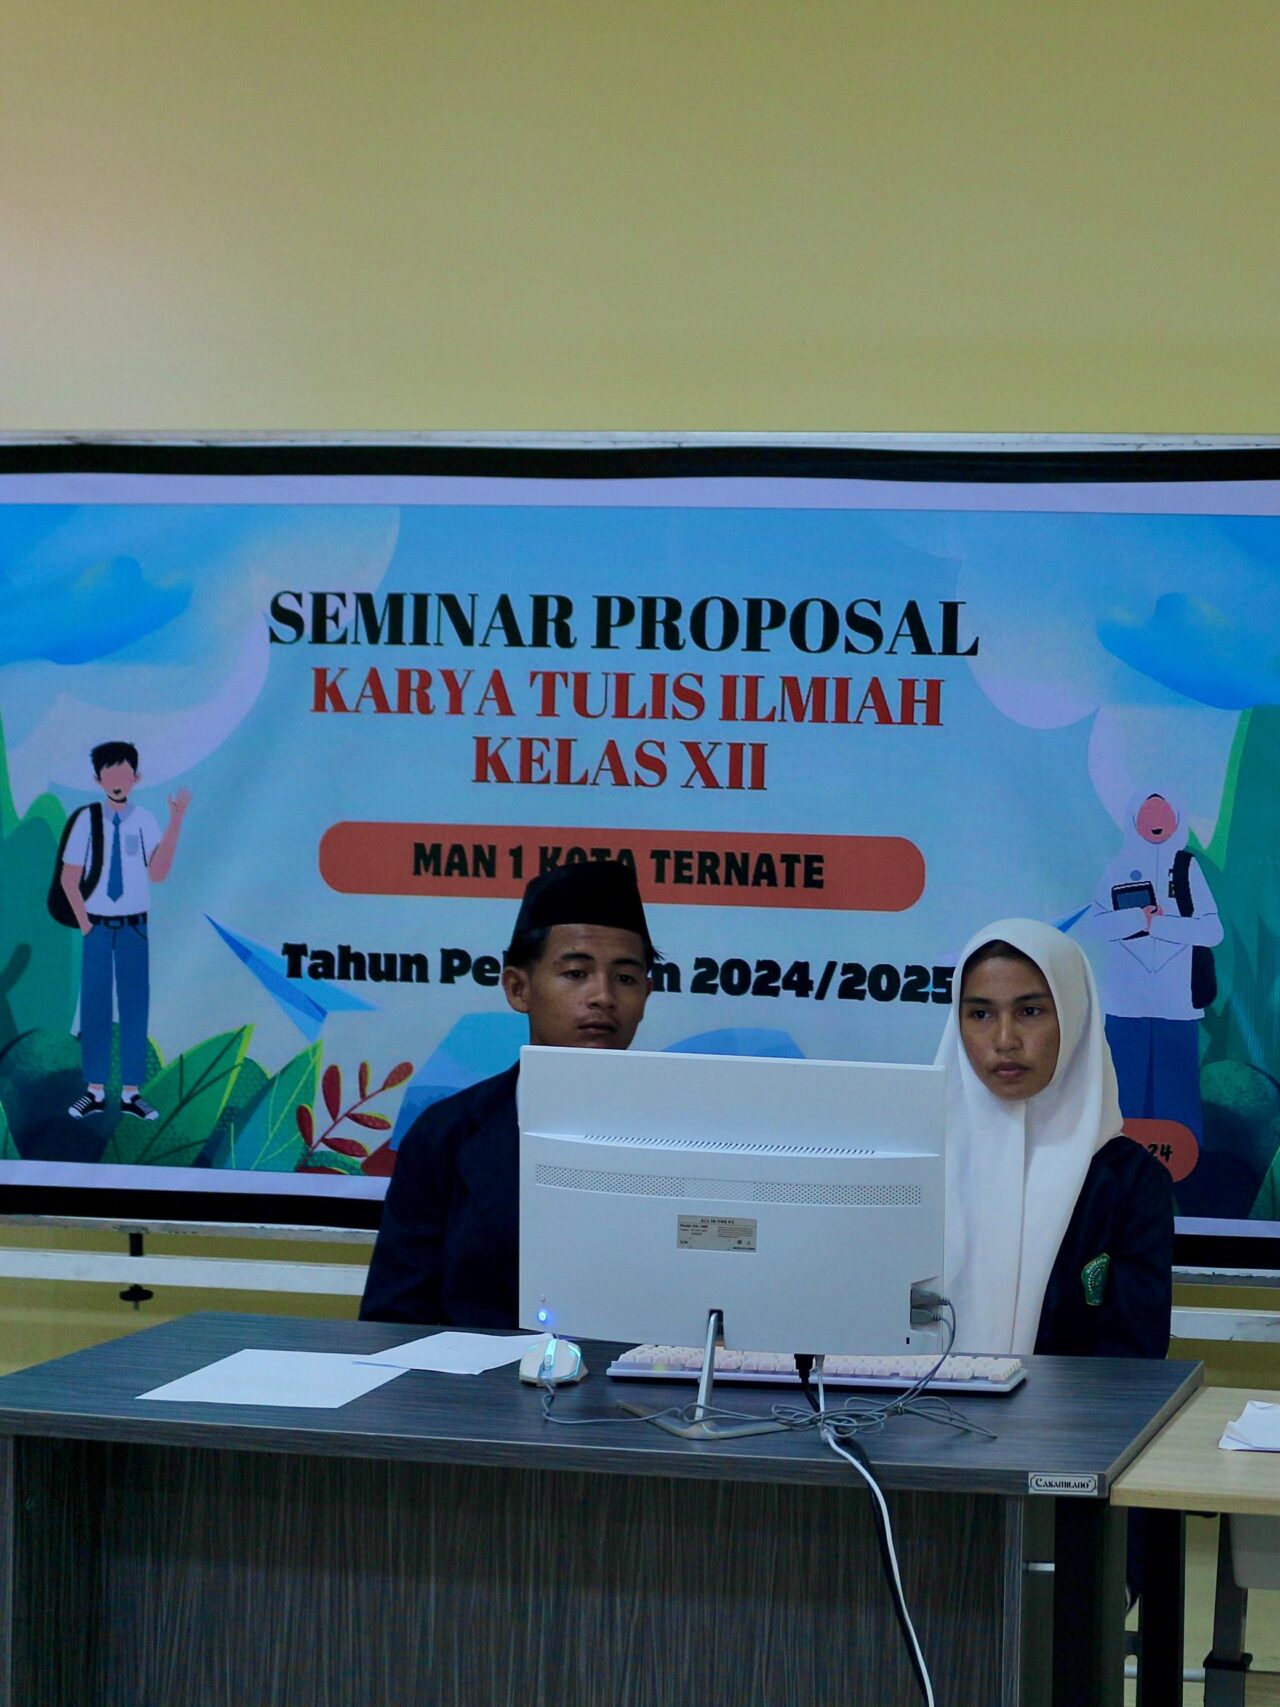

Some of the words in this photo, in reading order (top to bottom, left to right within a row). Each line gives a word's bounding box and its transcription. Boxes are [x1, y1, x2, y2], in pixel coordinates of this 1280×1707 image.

[268, 590, 575, 649] SEMINAR
[590, 595, 981, 658] PROPOSAL
[310, 667, 515, 718] KARYA
[529, 671, 706, 722] TULIS
[718, 675, 946, 728] ILMIAH
[472, 736, 668, 788] KELAS
[681, 740, 769, 791] XII
[412, 842, 497, 879] MAN
[509, 845, 525, 879] 1
[650, 849, 826, 889] TERNATE
[281, 943, 430, 984] Tahun
[690, 957, 956, 1004] 2024/2025
